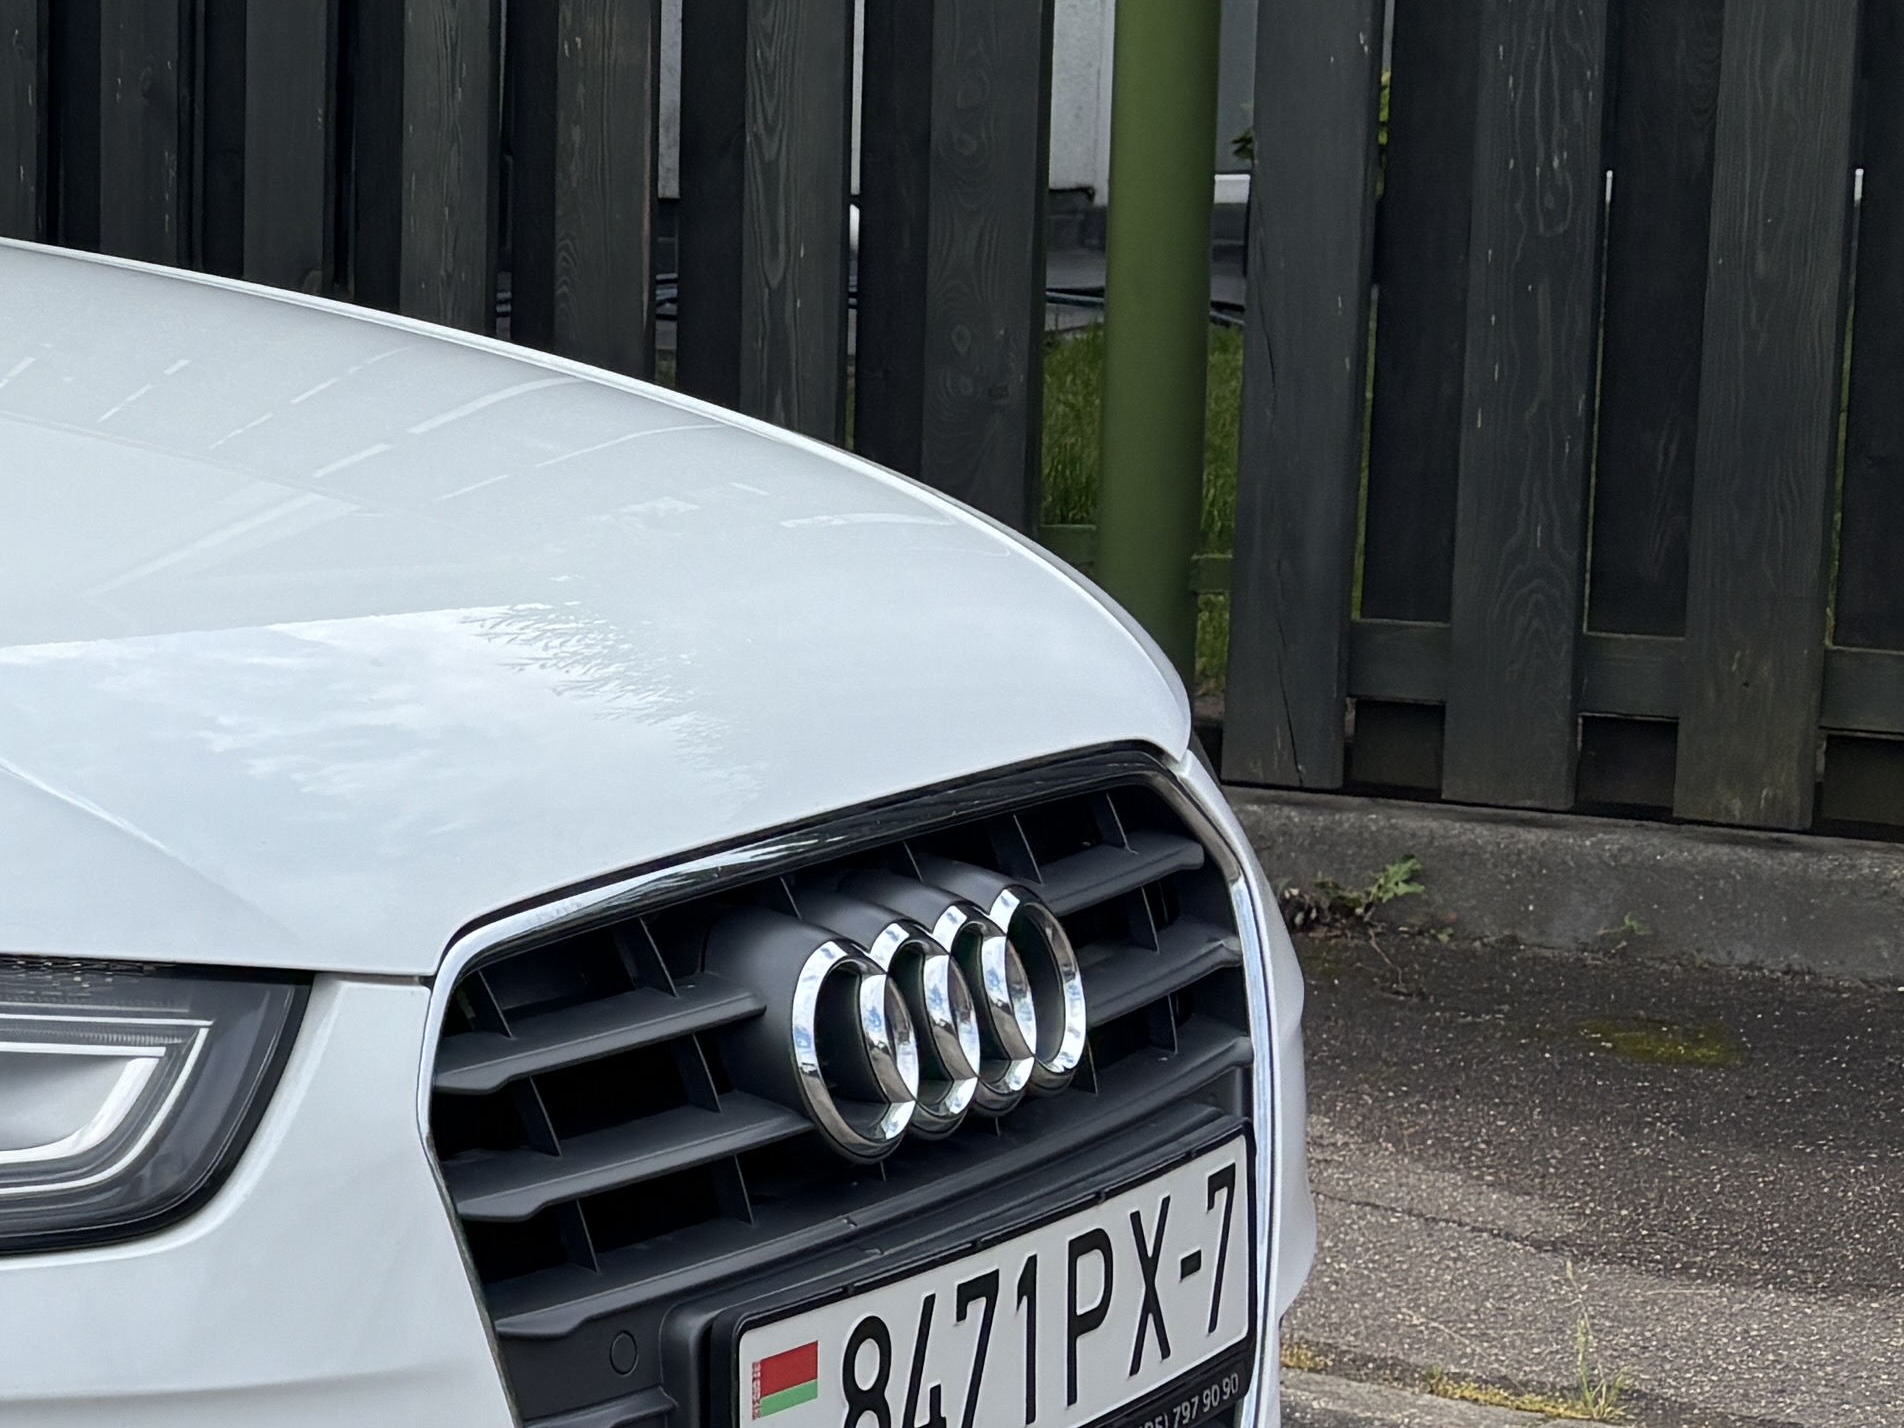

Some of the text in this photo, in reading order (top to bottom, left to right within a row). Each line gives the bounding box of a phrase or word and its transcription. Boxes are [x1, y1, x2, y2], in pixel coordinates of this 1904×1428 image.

[1173, 1396, 1199, 1428] 797
[1203, 1384, 1220, 1412] 90
[1222, 1373, 1239, 1400] 90
